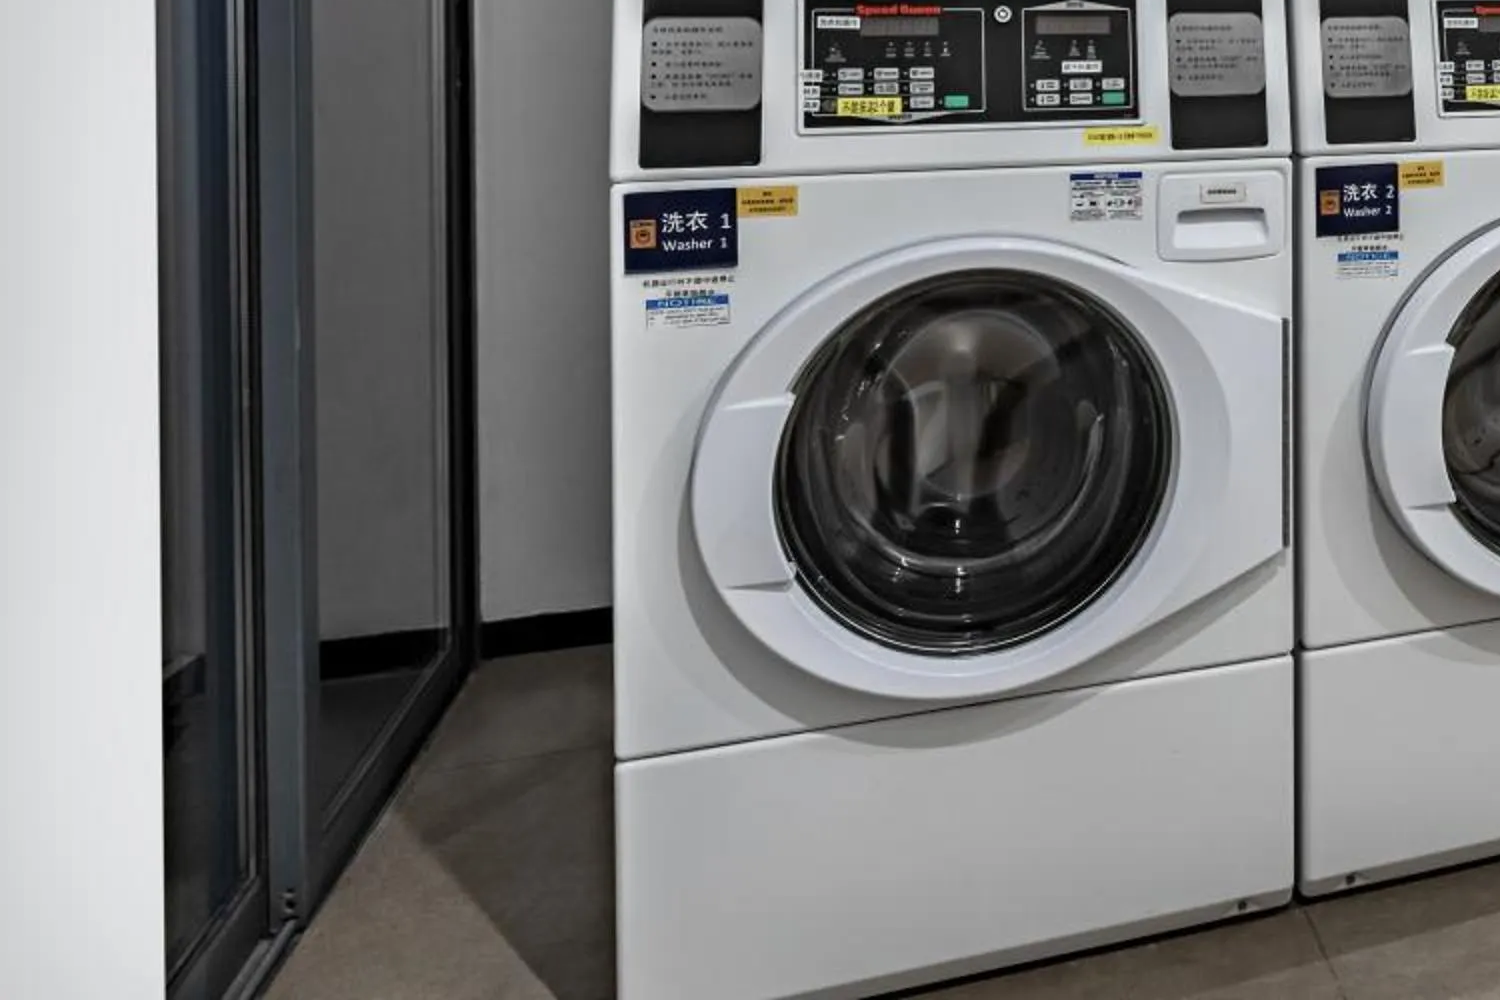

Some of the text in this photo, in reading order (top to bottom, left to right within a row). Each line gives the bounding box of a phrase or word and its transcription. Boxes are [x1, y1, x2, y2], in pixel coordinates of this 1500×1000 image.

[1343, 183, 1395, 203] 洗衣 2
[1343, 205, 1381, 217] Washer
[661, 210, 732, 233] 洗衣 1
[662, 237, 728, 252] Washer 1
